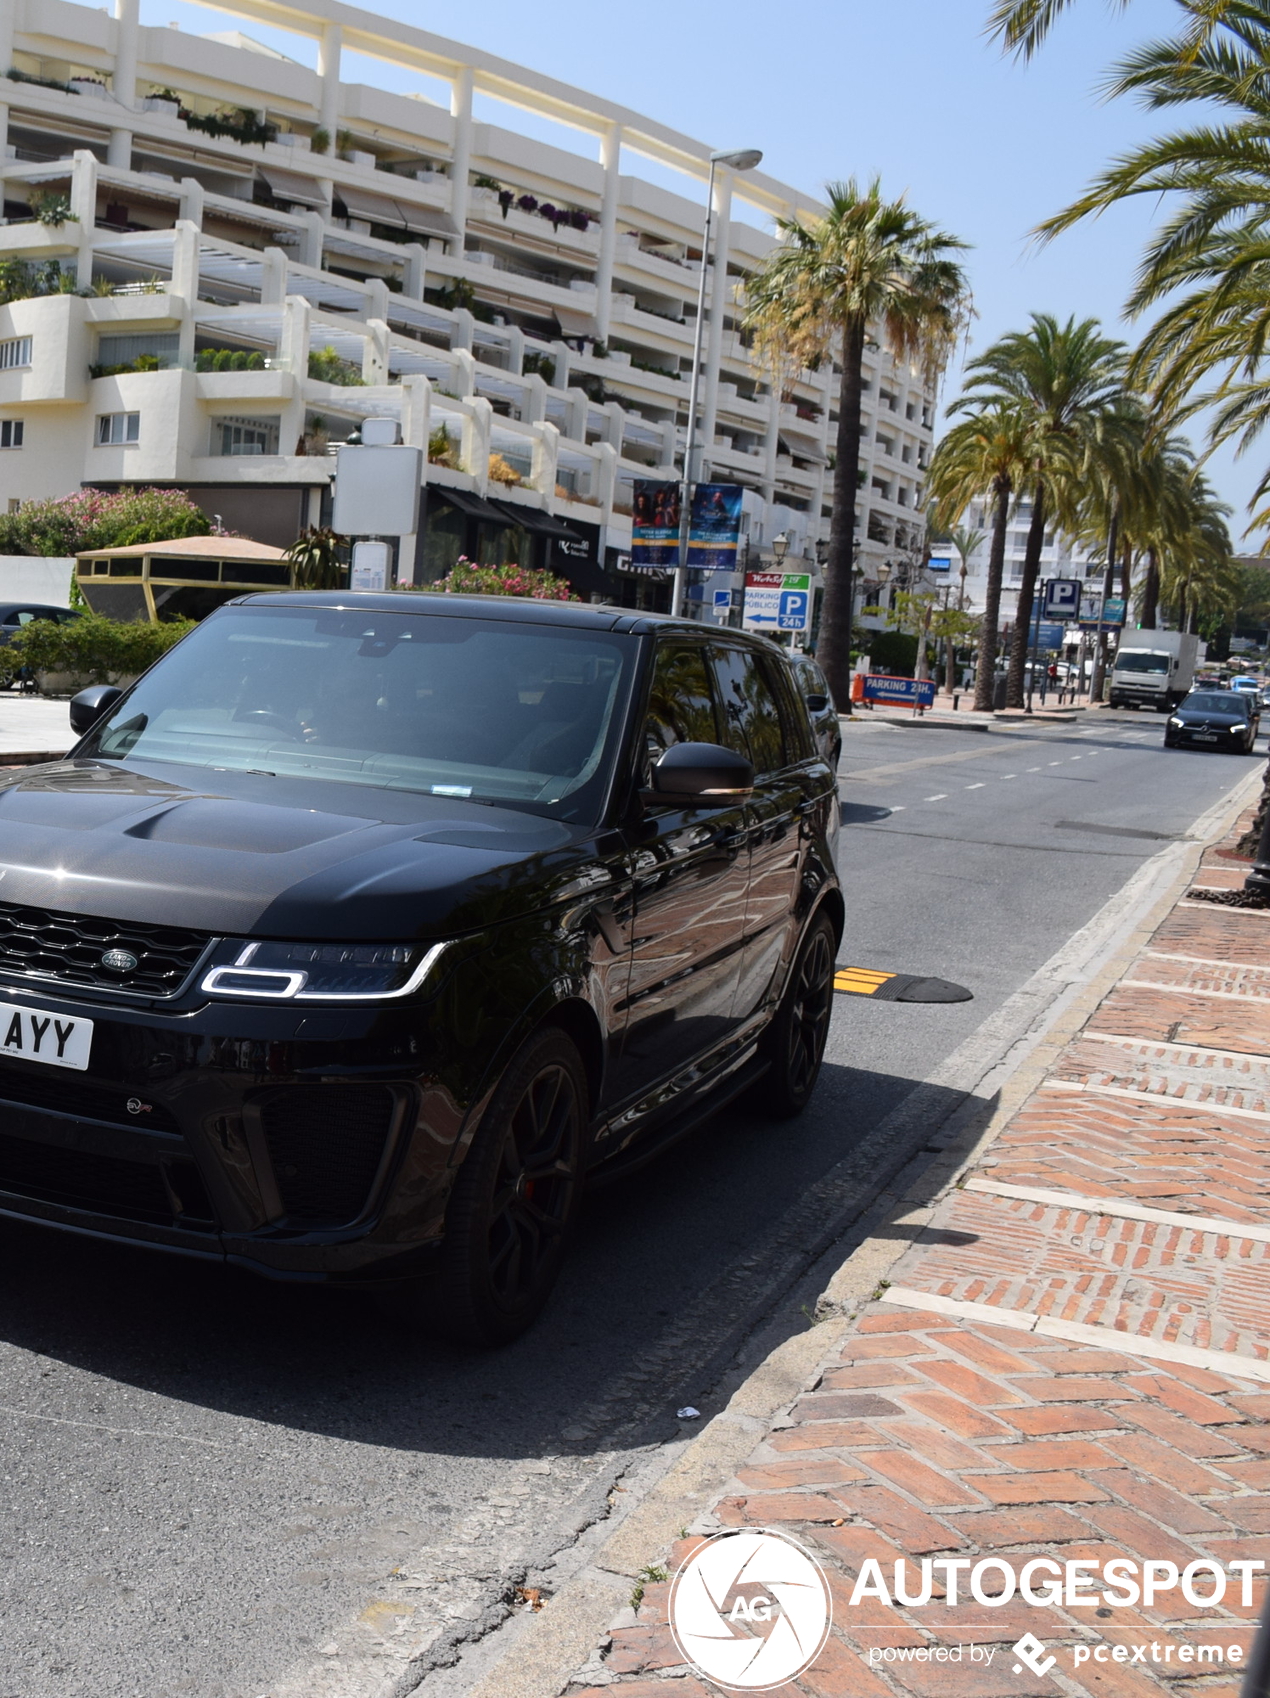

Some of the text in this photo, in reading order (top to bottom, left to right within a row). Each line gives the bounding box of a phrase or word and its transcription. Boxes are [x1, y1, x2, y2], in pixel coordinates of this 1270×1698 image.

[745, 592, 780, 600] PARKING
[1053, 584, 1073, 604] P
[786, 595, 802, 615] P
[781, 617, 802, 628] 24h
[866, 678, 907, 692] PARKING
[109, 953, 128, 961] LAND
[108, 960, 131, 968] ROVER
[4, 1012, 75, 1058] AYY
